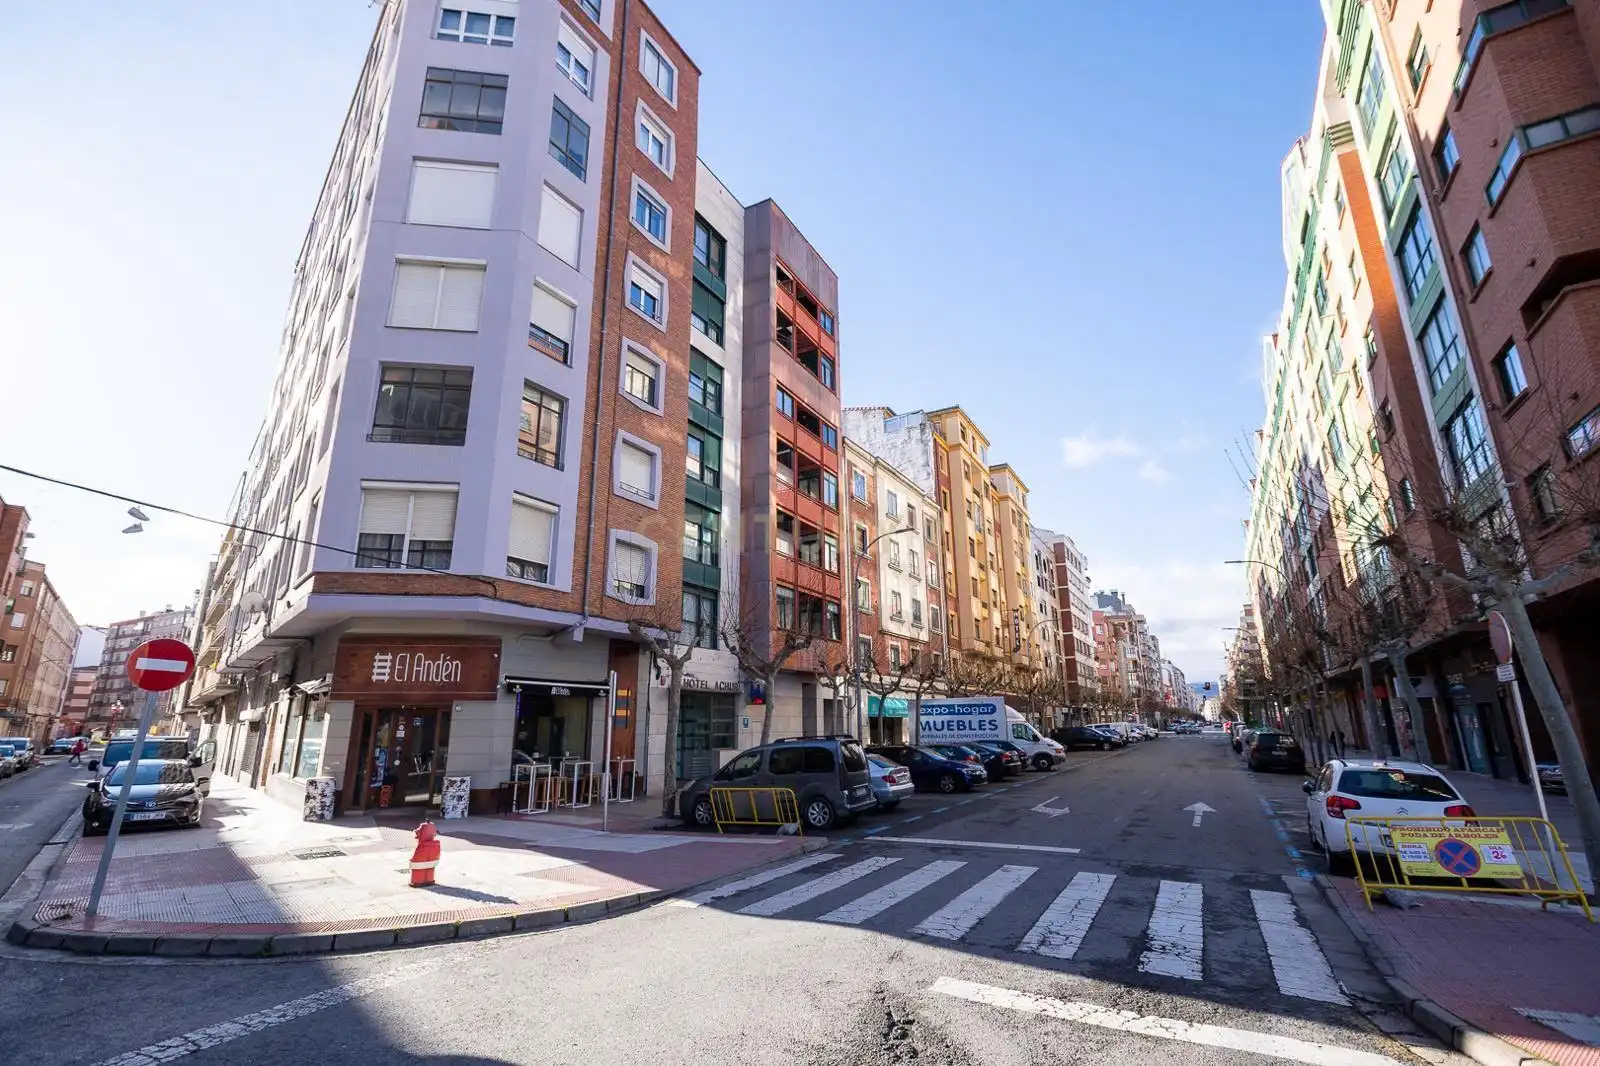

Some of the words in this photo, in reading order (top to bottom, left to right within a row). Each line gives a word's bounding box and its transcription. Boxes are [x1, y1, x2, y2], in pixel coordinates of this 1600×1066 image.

[394, 653, 410, 682] El
[411, 653, 461, 682] Andén
[683, 678, 708, 689] HOTEL
[920, 704, 993, 715] expo-hogar
[920, 720, 998, 731] MUEBLES
[1492, 850, 1508, 860] 26
